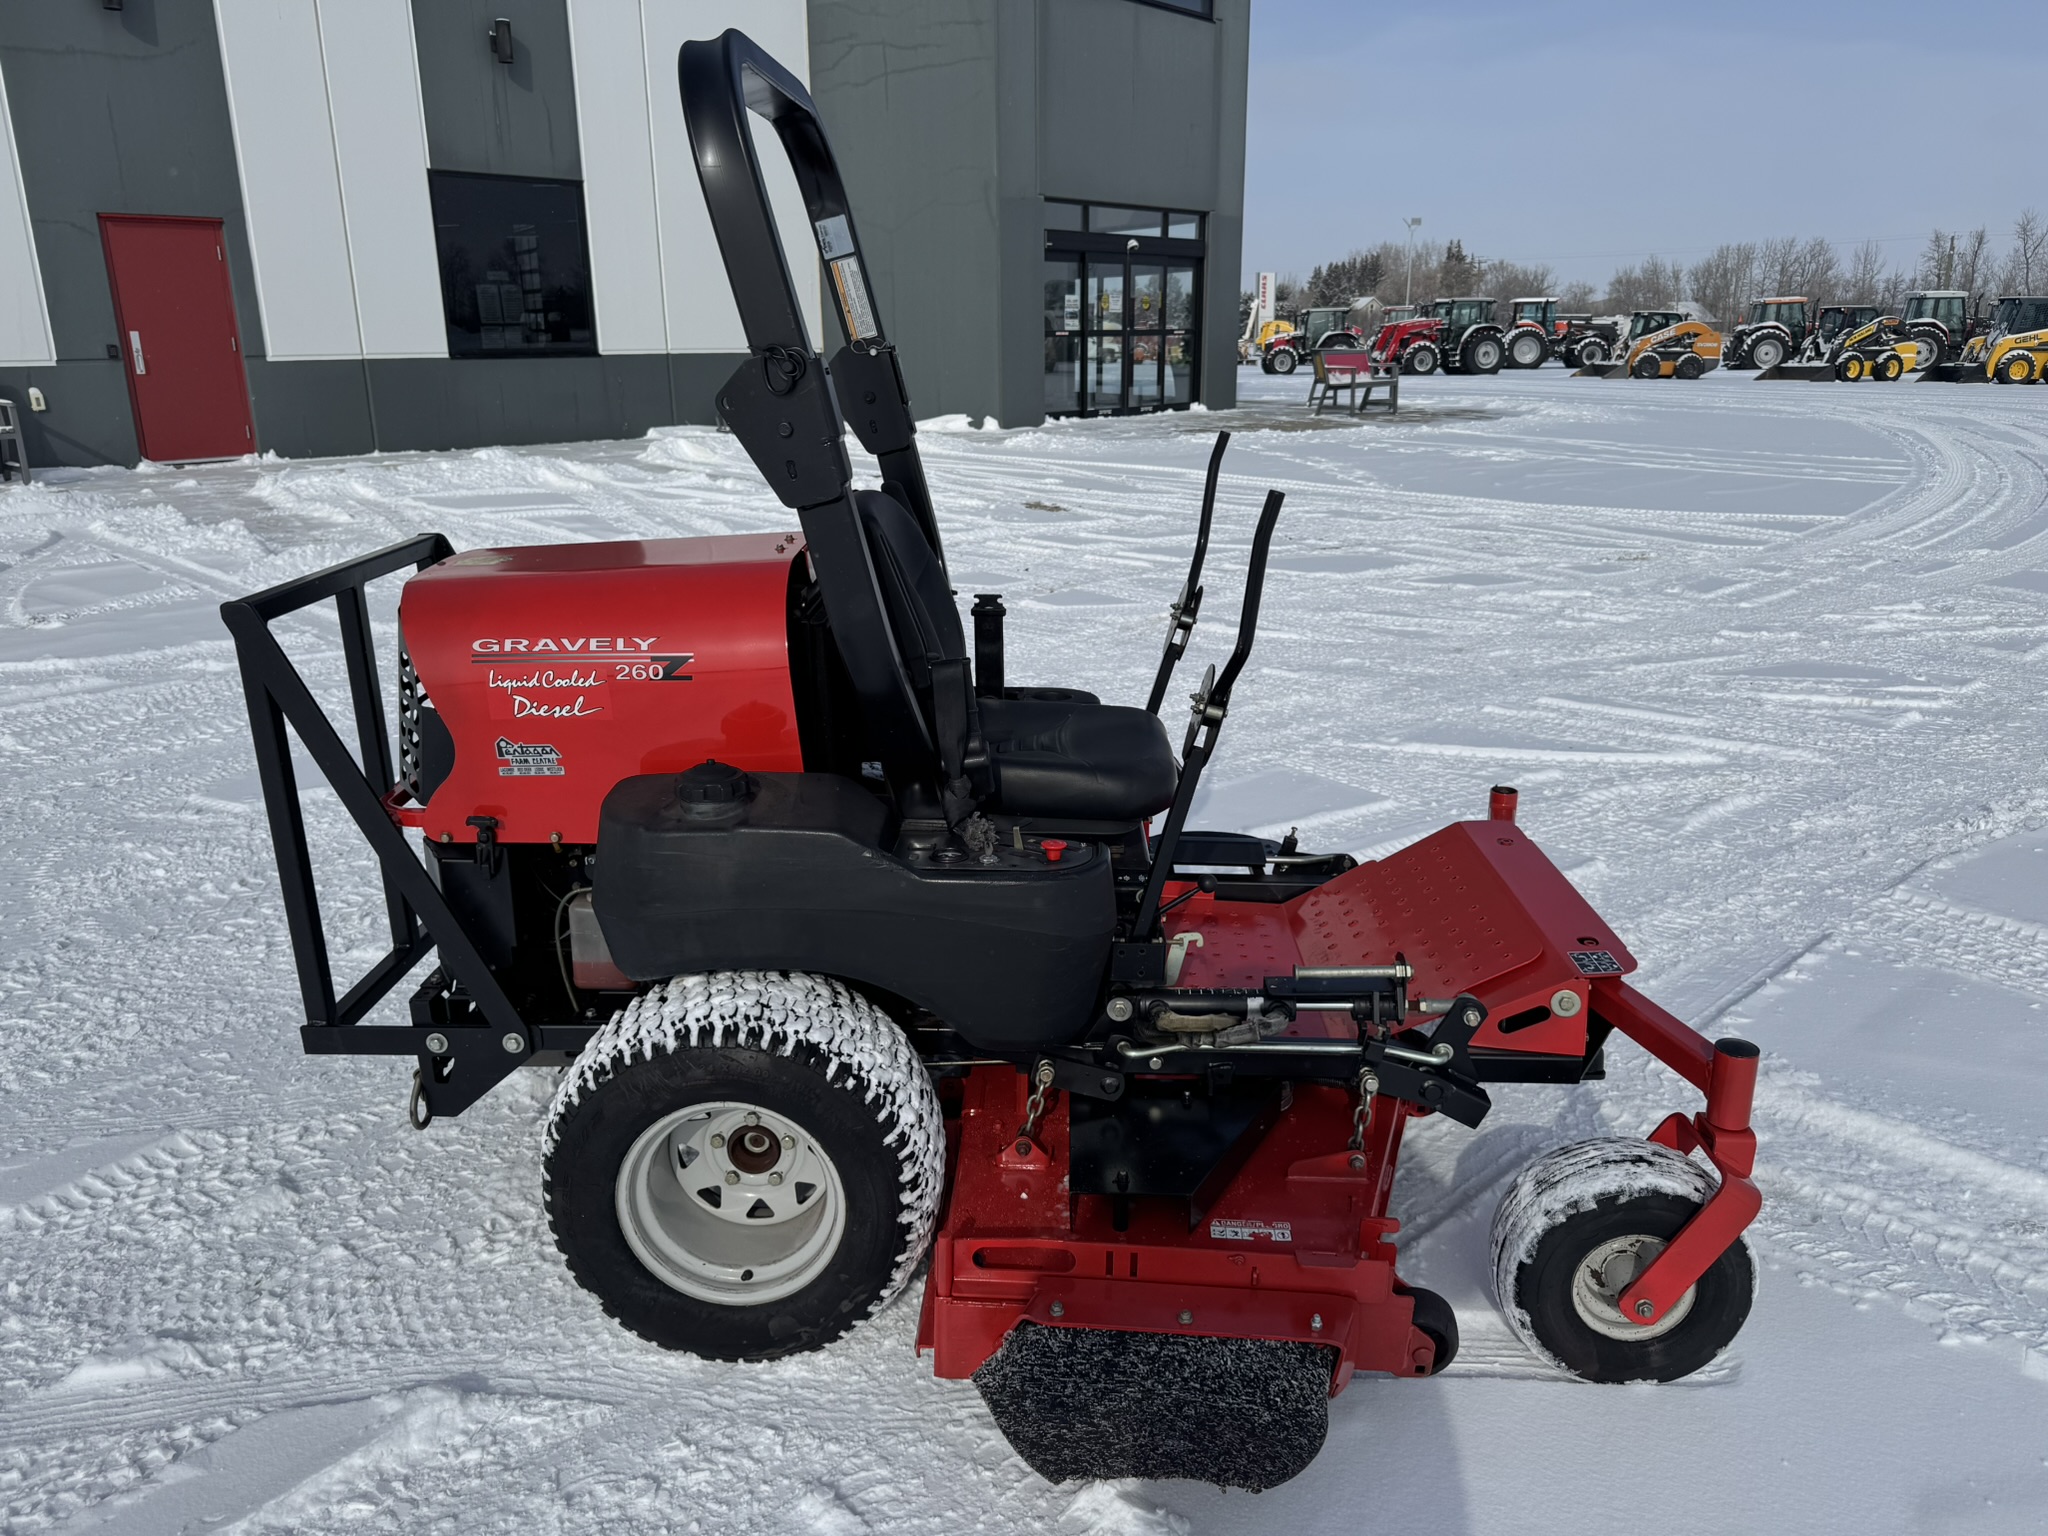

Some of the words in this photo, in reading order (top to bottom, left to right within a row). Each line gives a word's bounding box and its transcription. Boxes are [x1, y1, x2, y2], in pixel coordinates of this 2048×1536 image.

[1650, 328, 1676, 343] CASE
[2014, 333, 2042, 344] GEHL
[472, 637, 658, 652] GRAVELY
[489, 669, 541, 695] Liquid
[542, 669, 607, 688] Cooled
[512, 695, 604, 718] Diesel
